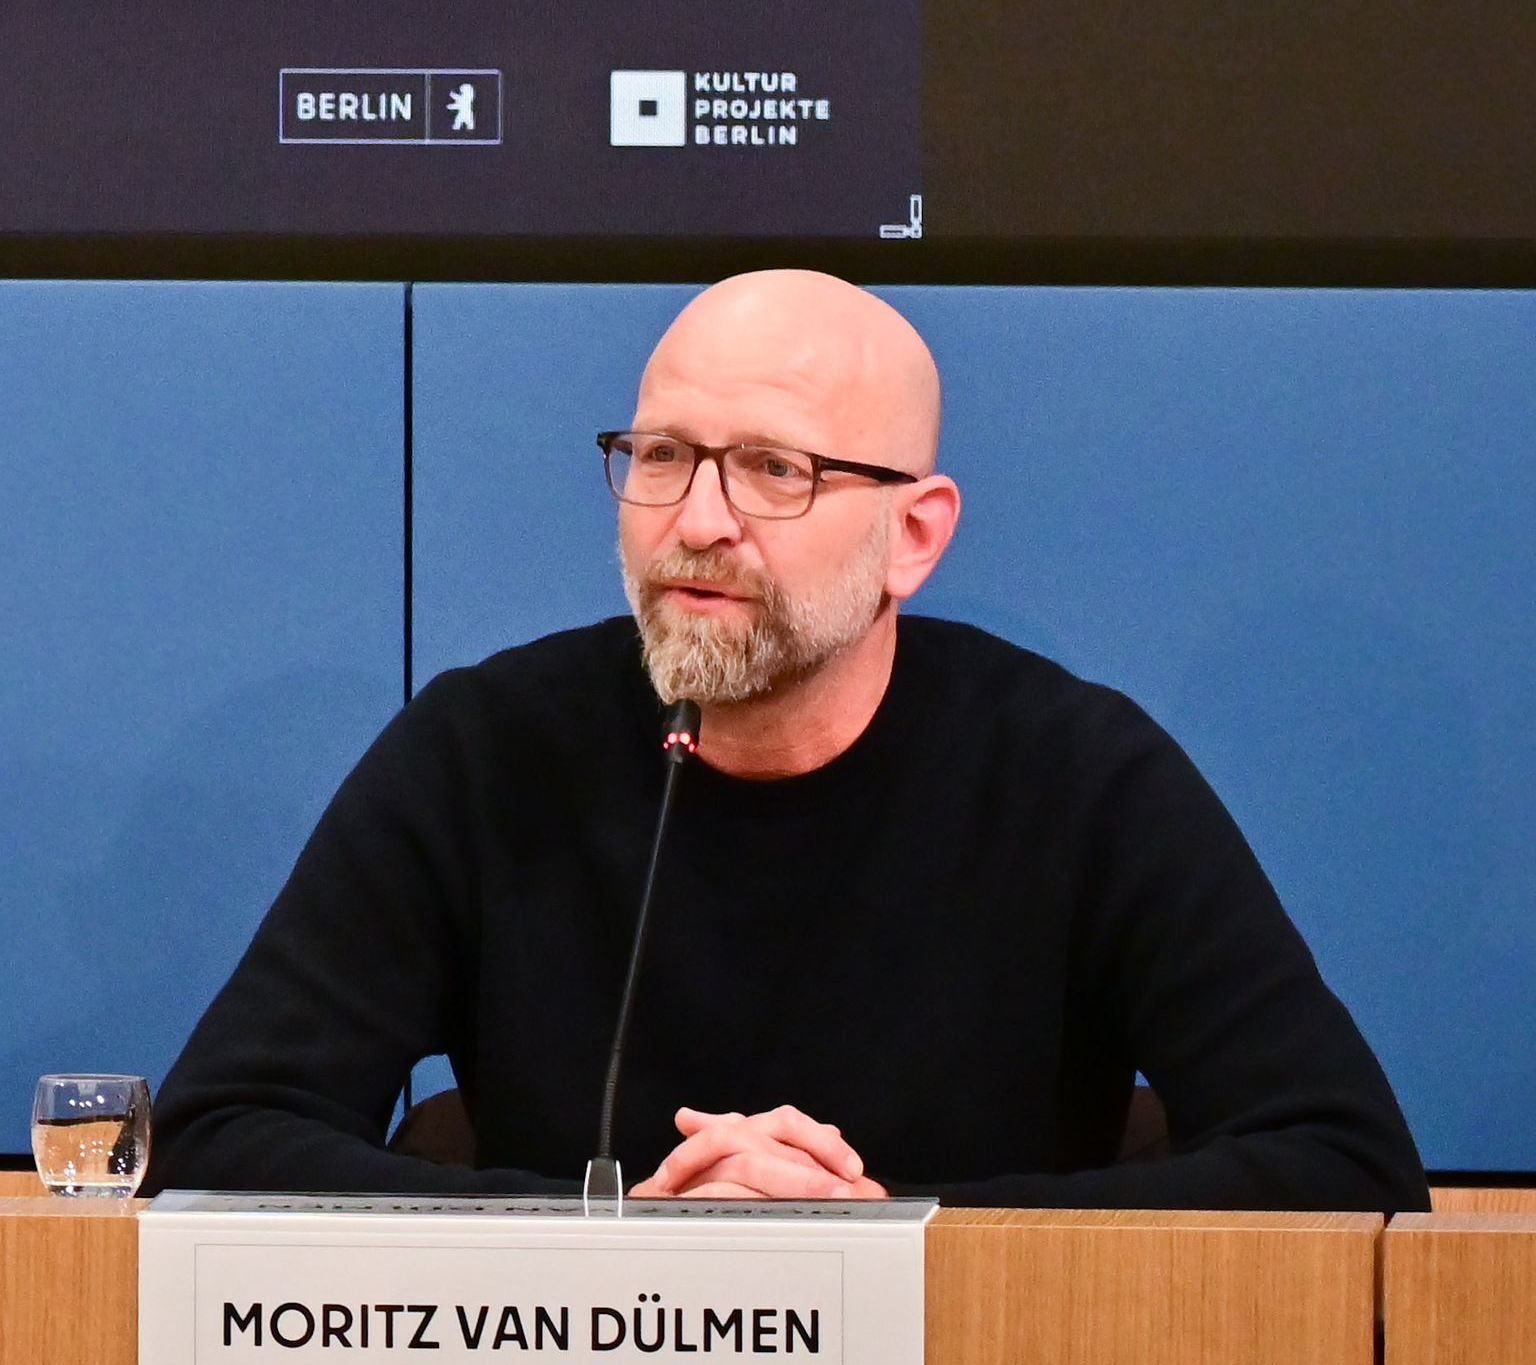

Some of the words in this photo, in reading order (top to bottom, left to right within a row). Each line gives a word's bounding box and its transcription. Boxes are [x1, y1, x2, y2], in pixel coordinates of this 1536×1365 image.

[694, 72, 798, 94] KULTUR
[296, 91, 413, 122] BERLIN
[694, 98, 830, 121] PROJEKTE
[694, 124, 798, 146] BERLIN
[222, 1301, 440, 1350] MORITZ
[455, 1304, 569, 1351] VAN
[591, 1293, 820, 1354] DÜLMEN
